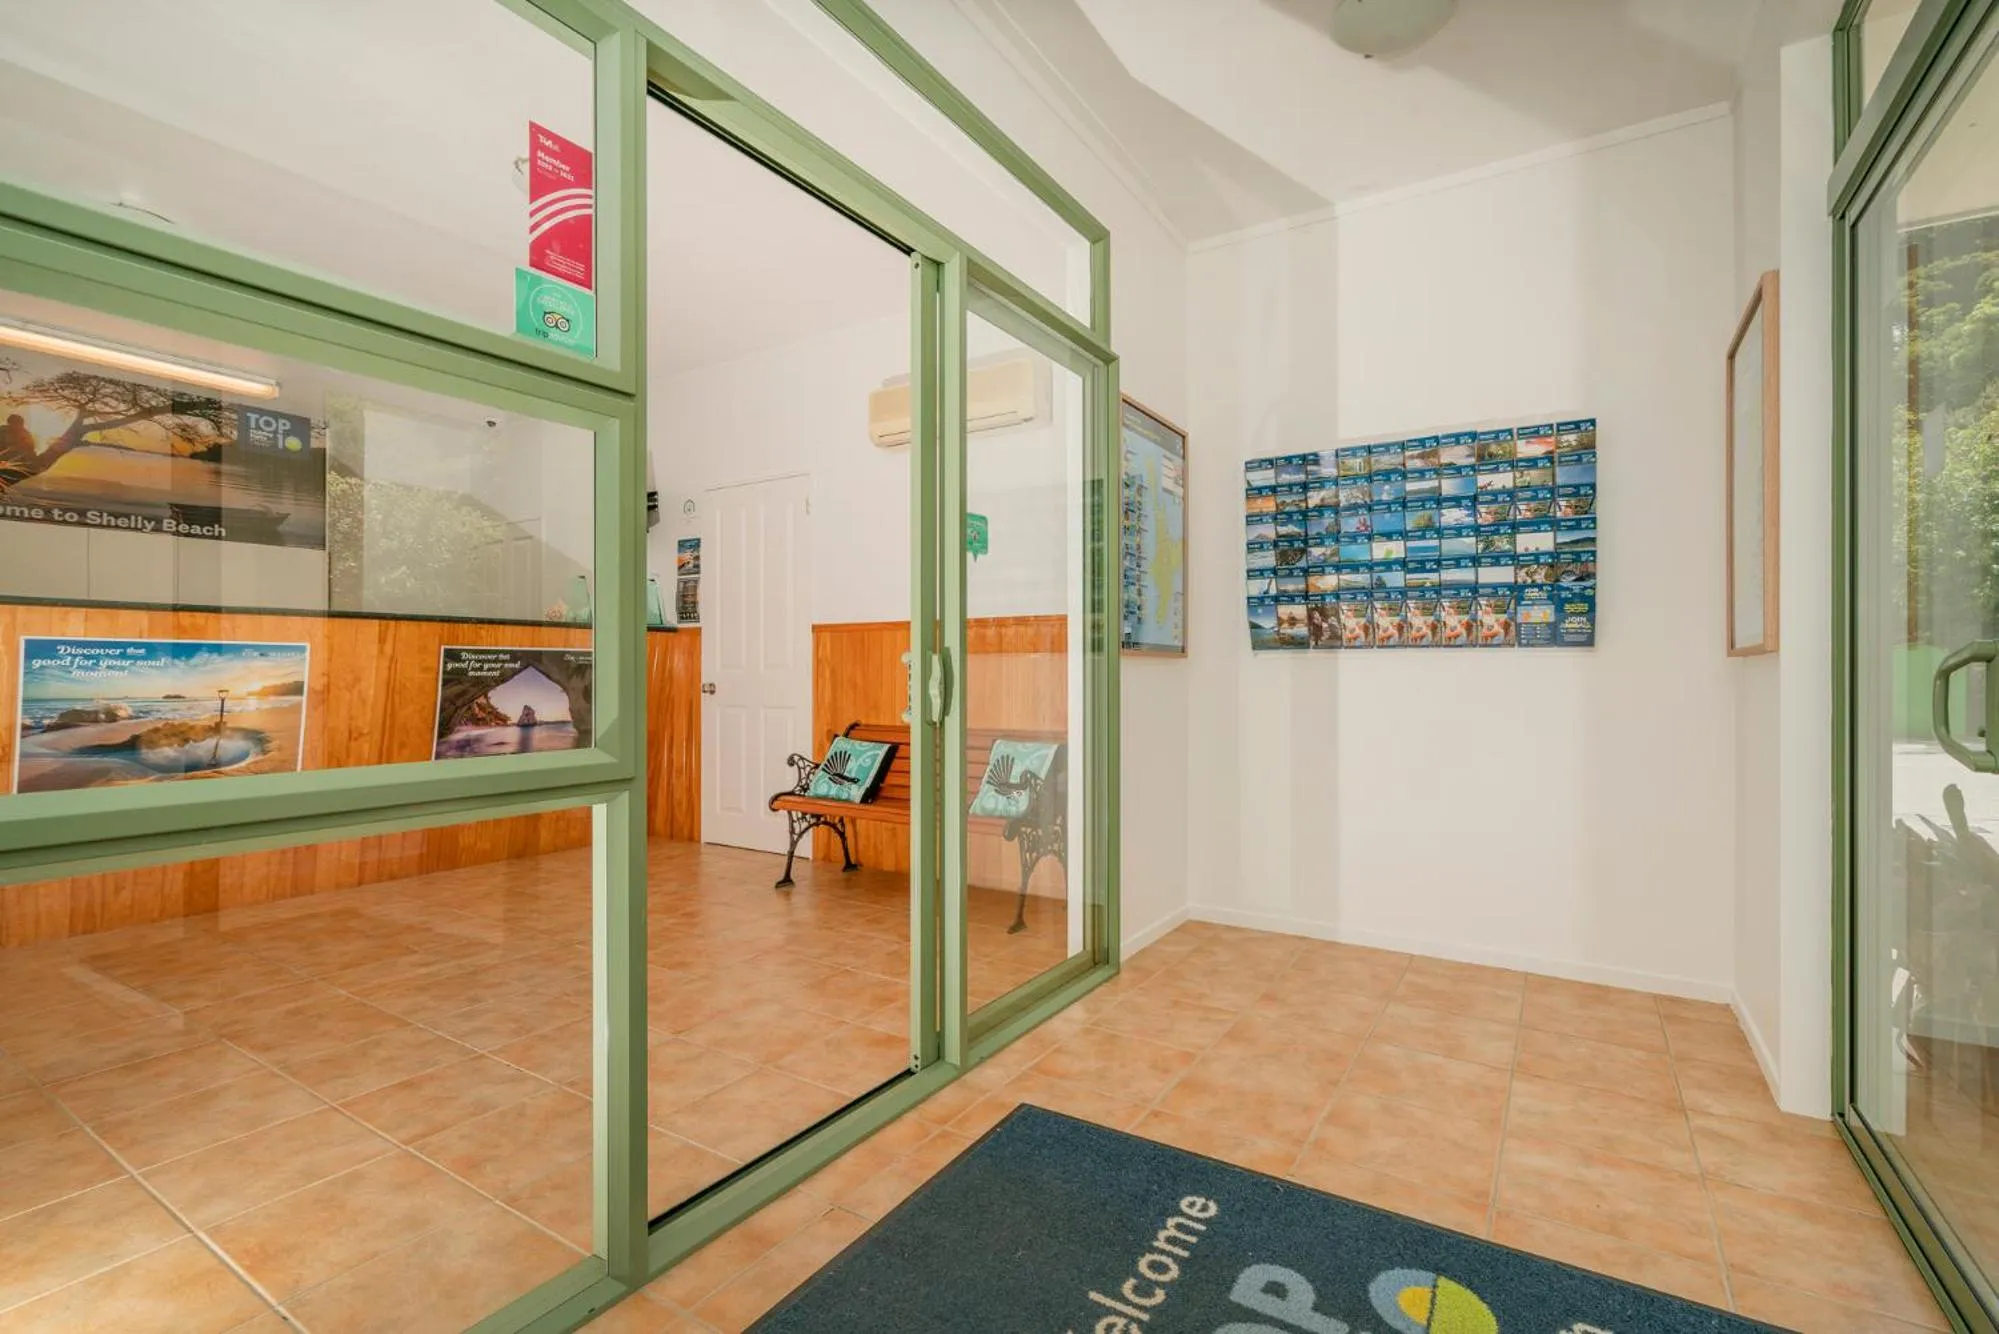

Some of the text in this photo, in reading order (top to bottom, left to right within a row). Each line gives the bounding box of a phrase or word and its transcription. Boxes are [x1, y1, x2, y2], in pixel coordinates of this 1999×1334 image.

[246, 412, 291, 433] TOP
[52, 508, 79, 523] to
[86, 511, 156, 532] Shelly
[162, 519, 227, 537] Beach
[55, 644, 124, 656] Discover
[461, 651, 498, 661] Discover
[31, 656, 165, 669] good for your soul
[446, 661, 468, 671] good
[468, 660, 481, 671] for
[483, 662, 502, 671] your
[70, 669, 128, 678] moment
[1067, 1194, 1219, 1334] elcome
